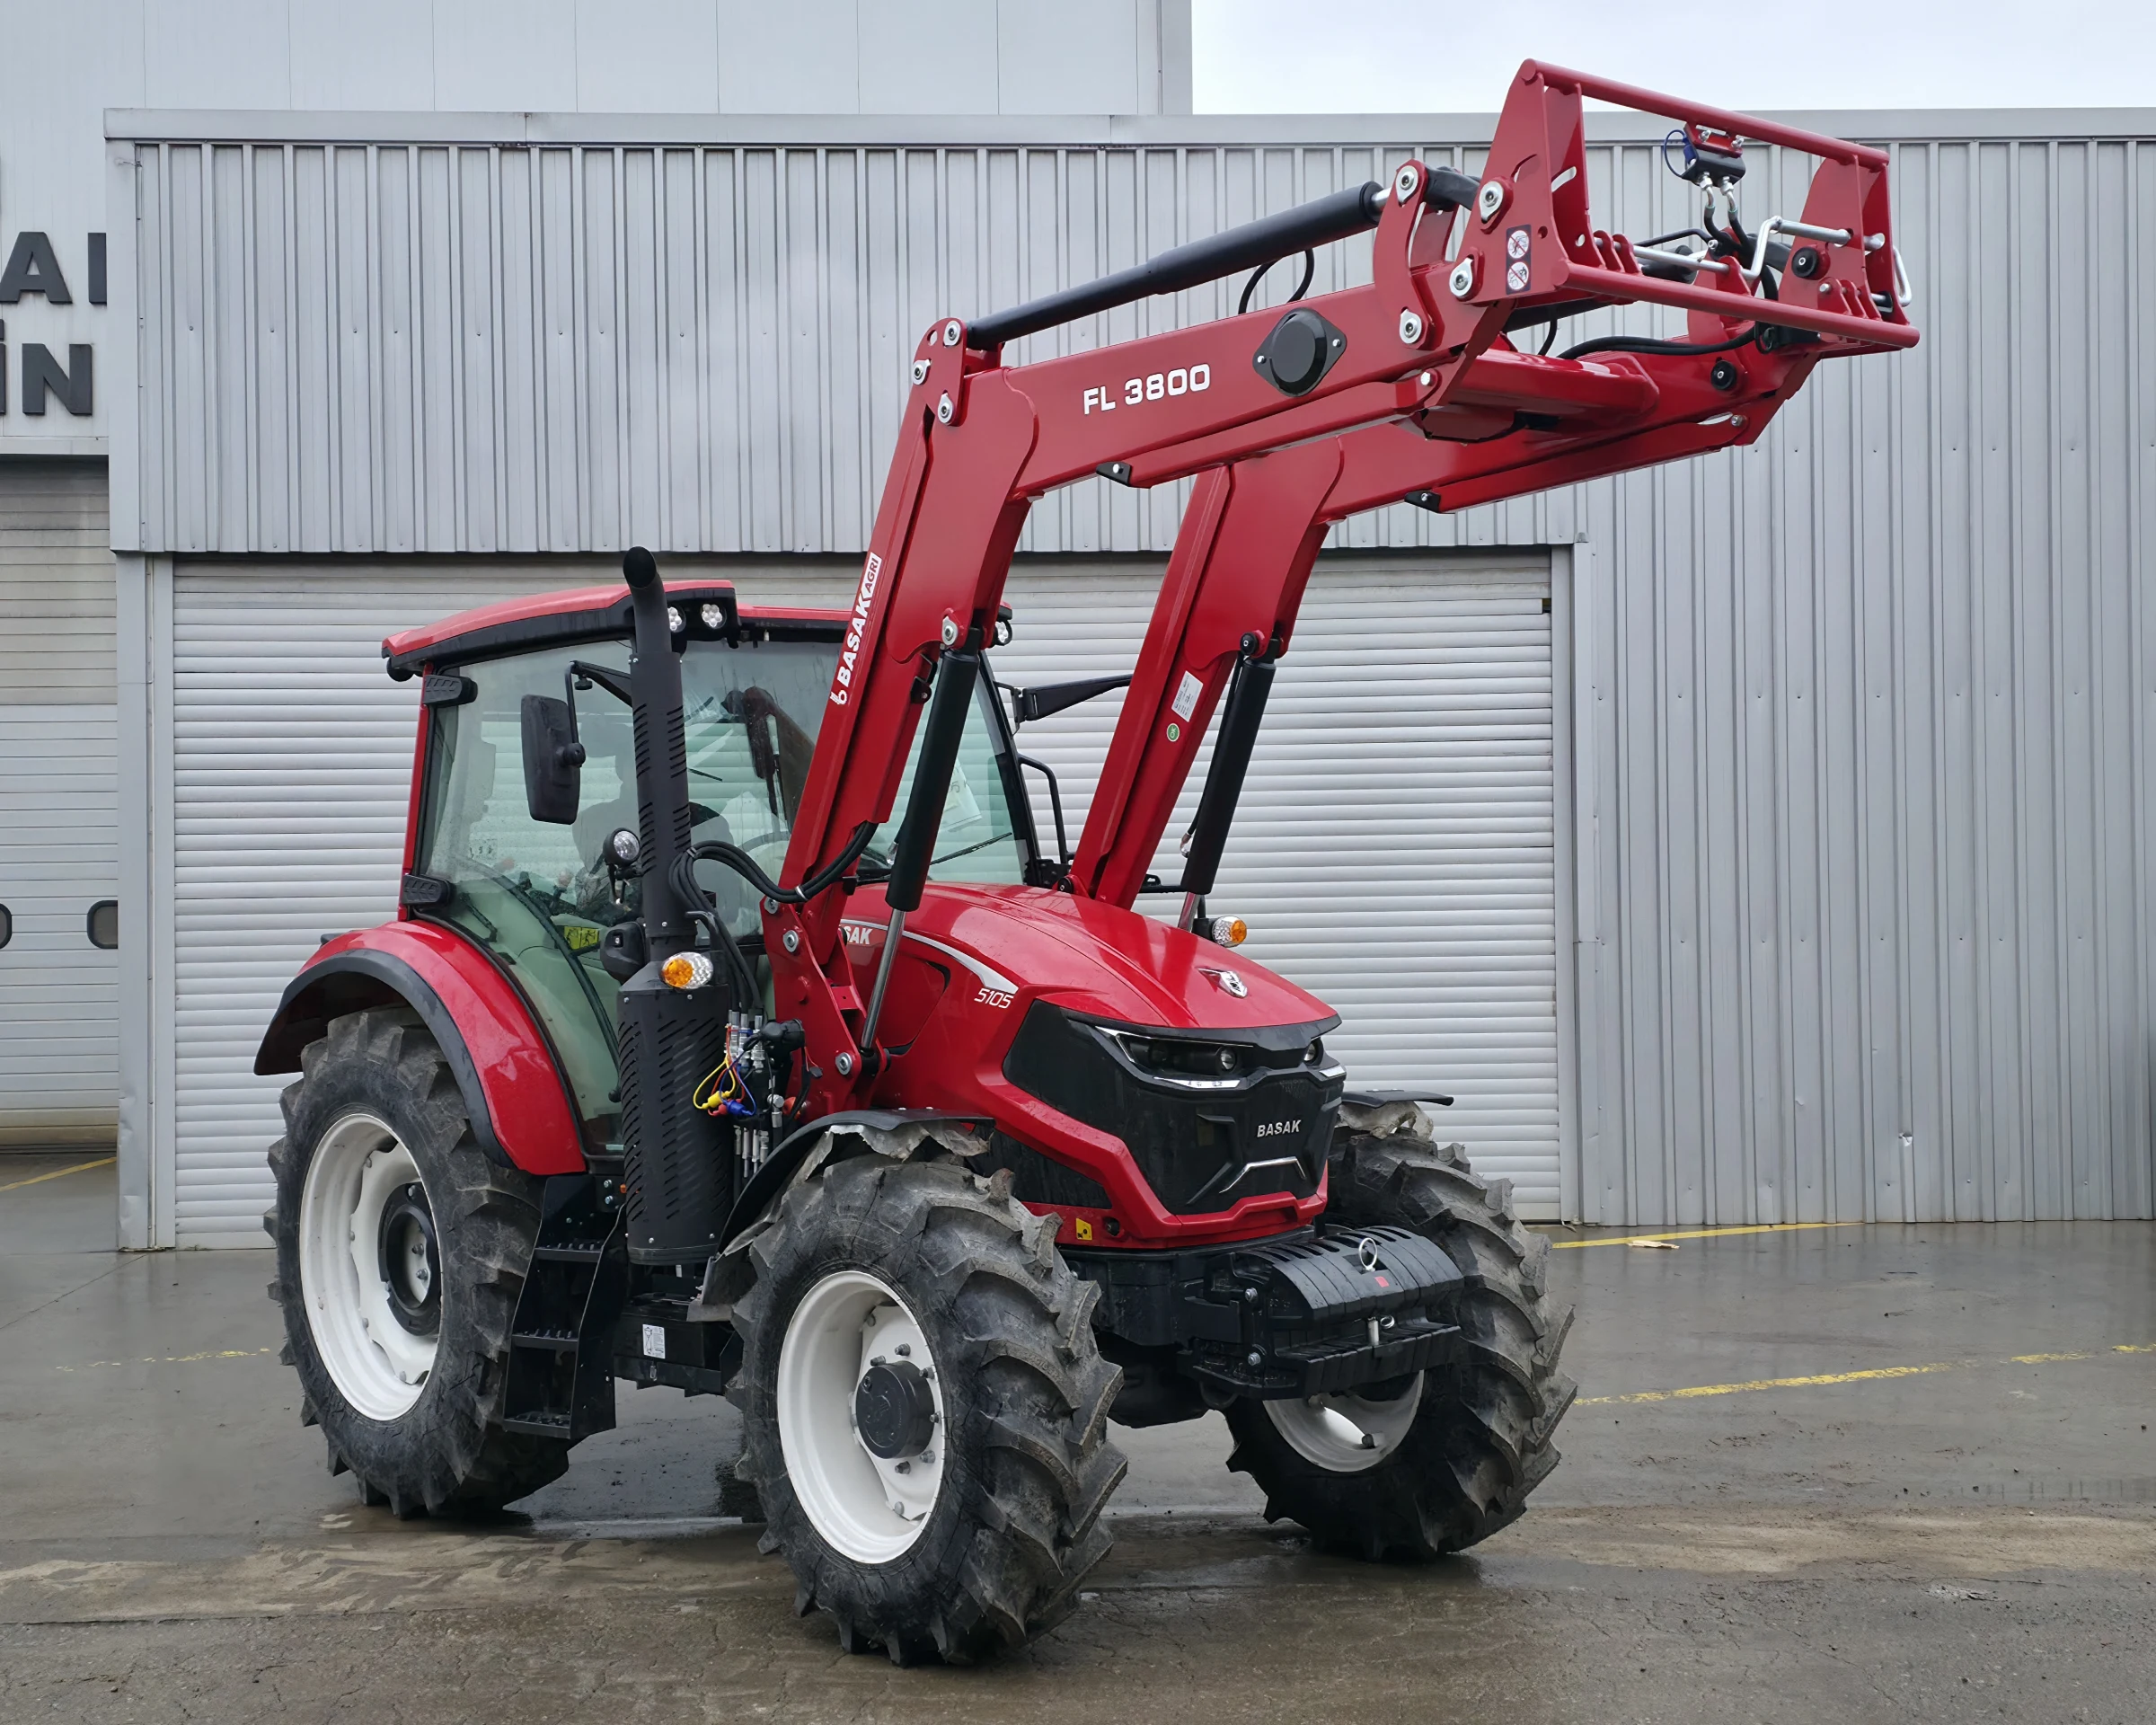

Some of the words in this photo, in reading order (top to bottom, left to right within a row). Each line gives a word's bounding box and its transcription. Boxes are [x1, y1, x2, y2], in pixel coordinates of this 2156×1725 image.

[1083, 385, 1116, 415] FL
[1125, 363, 1211, 405] 3800
[836, 593, 872, 687] BASAK
[864, 556, 879, 595] AGRI
[974, 987, 1014, 1008] 5105
[1257, 1119, 1301, 1137] BASAK
